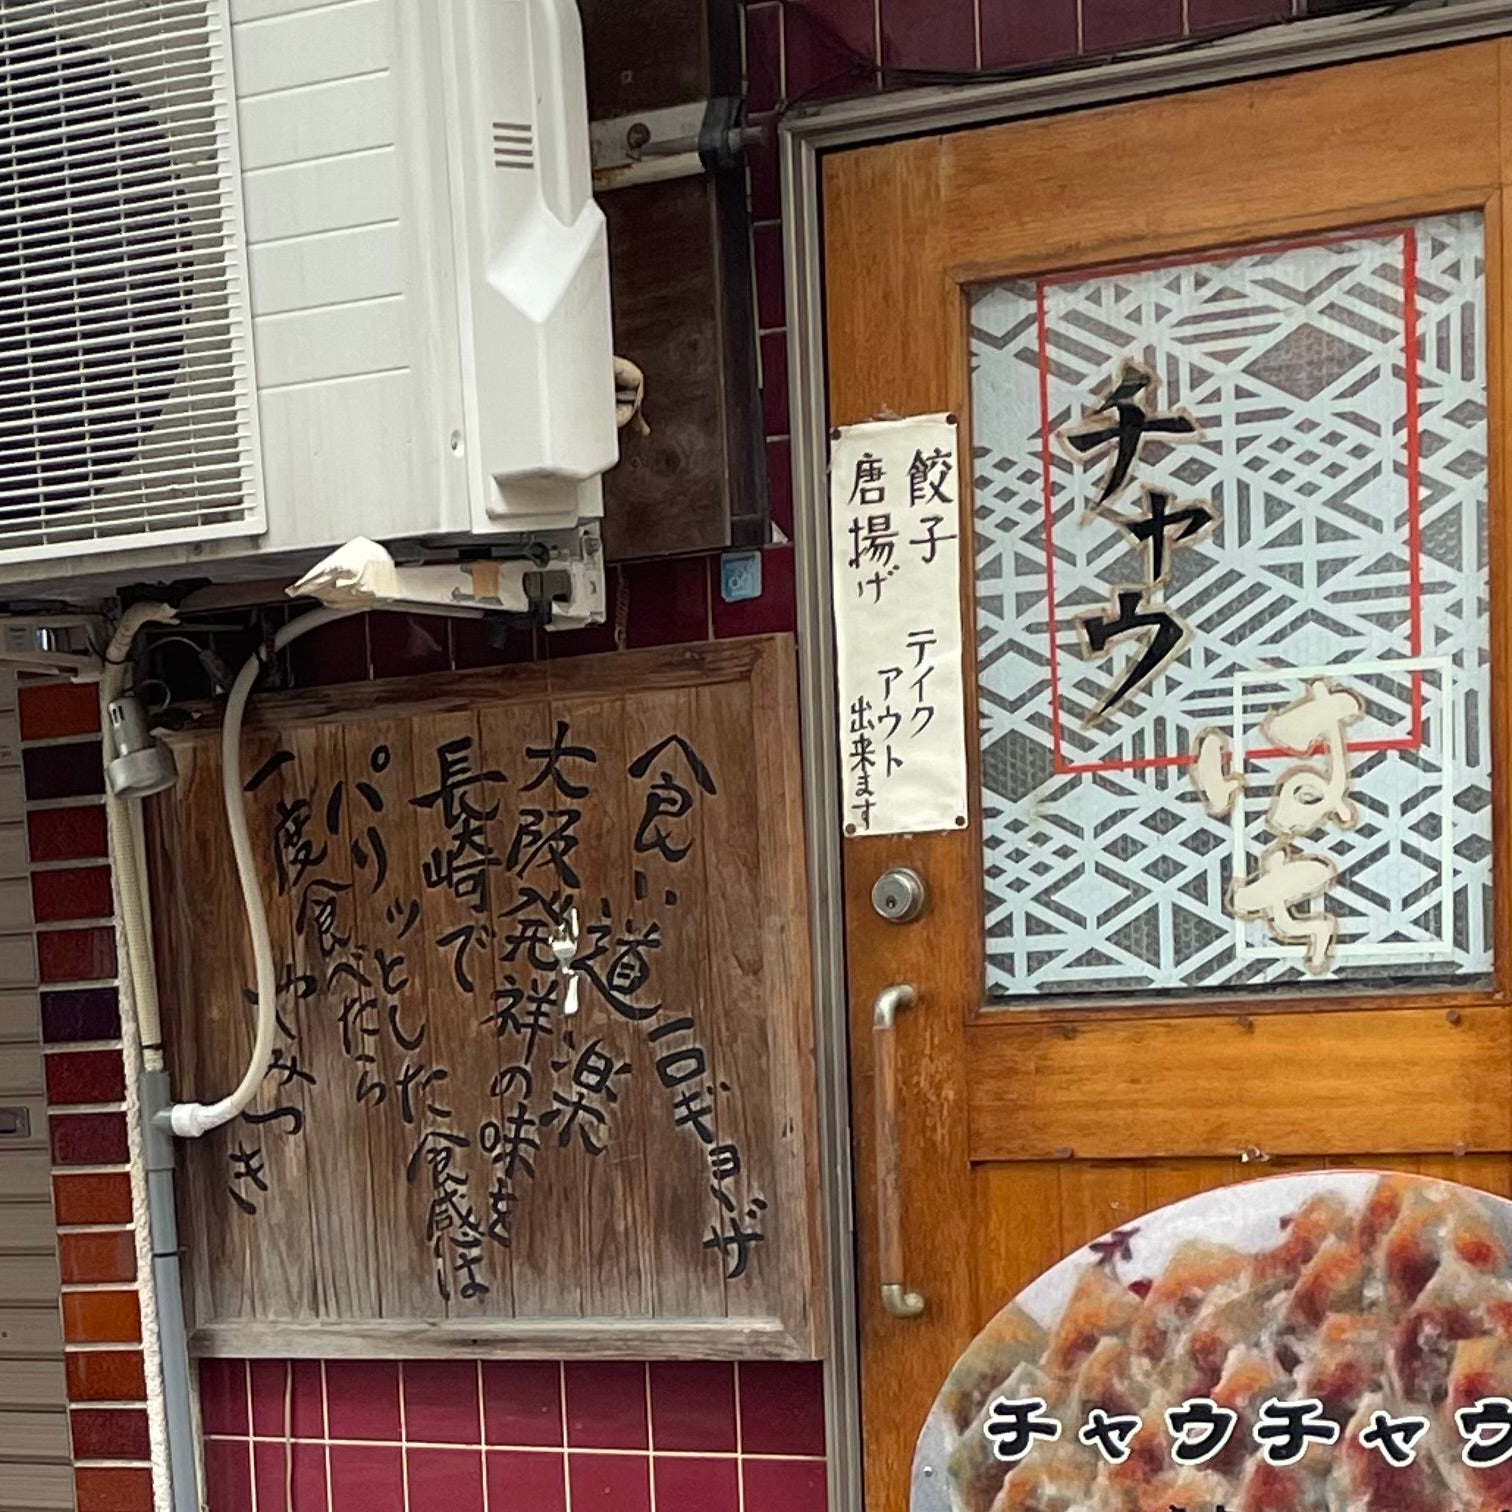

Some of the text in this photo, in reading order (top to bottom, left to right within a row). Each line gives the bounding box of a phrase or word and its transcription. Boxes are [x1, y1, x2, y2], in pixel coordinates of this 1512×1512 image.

[846, 453, 901, 605] 唐揚げ
[906, 448, 959, 565] 餃子
[876, 667, 905, 778] アウト
[905, 629, 938, 738] テイク
[848, 695, 877, 831] 出来ます
[409, 736, 507, 994] 長崎で
[984, 1397, 1512, 1467] チャウチャウ
